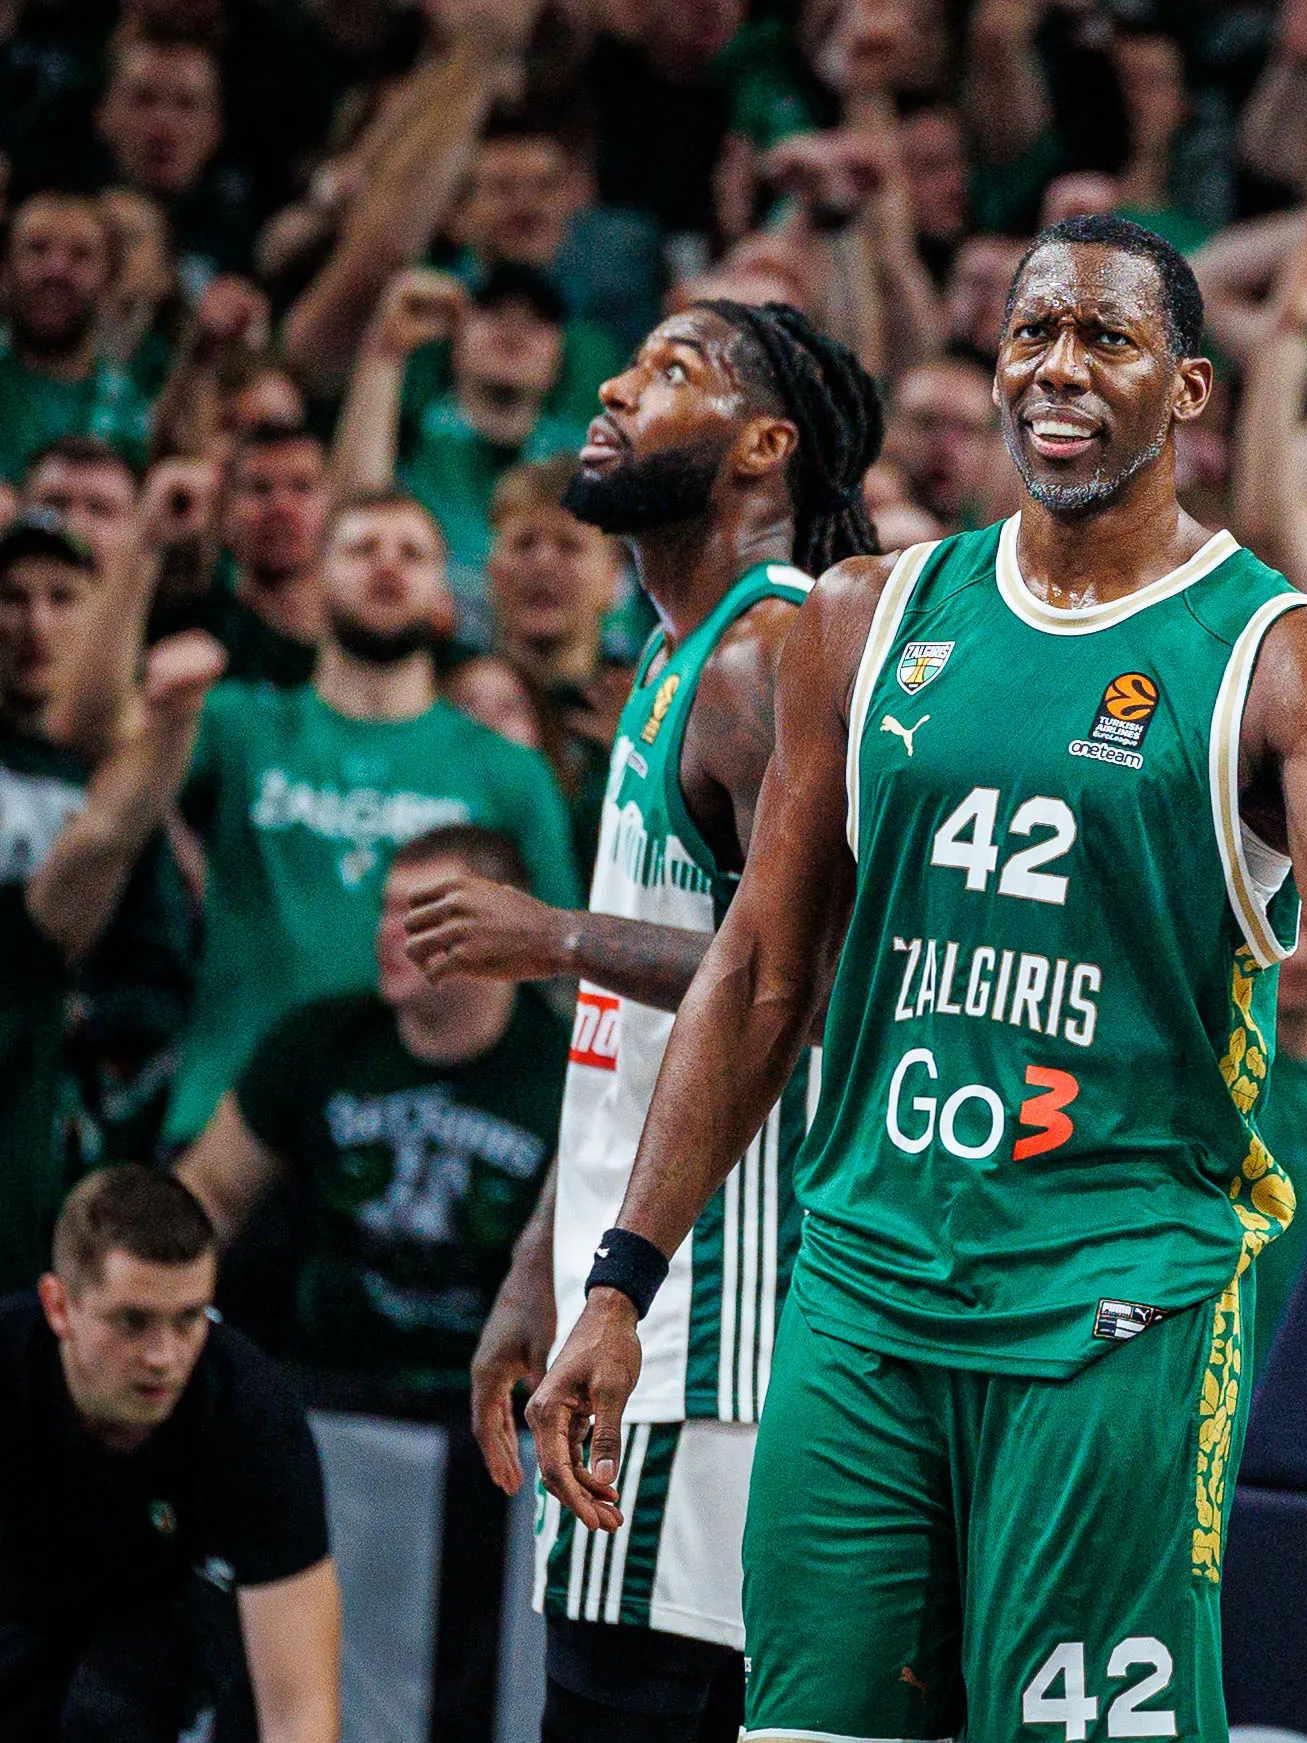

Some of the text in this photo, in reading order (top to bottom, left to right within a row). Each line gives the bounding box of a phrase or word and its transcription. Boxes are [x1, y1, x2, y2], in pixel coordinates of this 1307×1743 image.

[1095, 724, 1141, 740] AIRLINES
[1099, 716, 1144, 733] TURKISH
[1069, 741, 1143, 768] oneteam
[930, 785, 1077, 905] 42
[1023, 1636, 1178, 1741] 42
